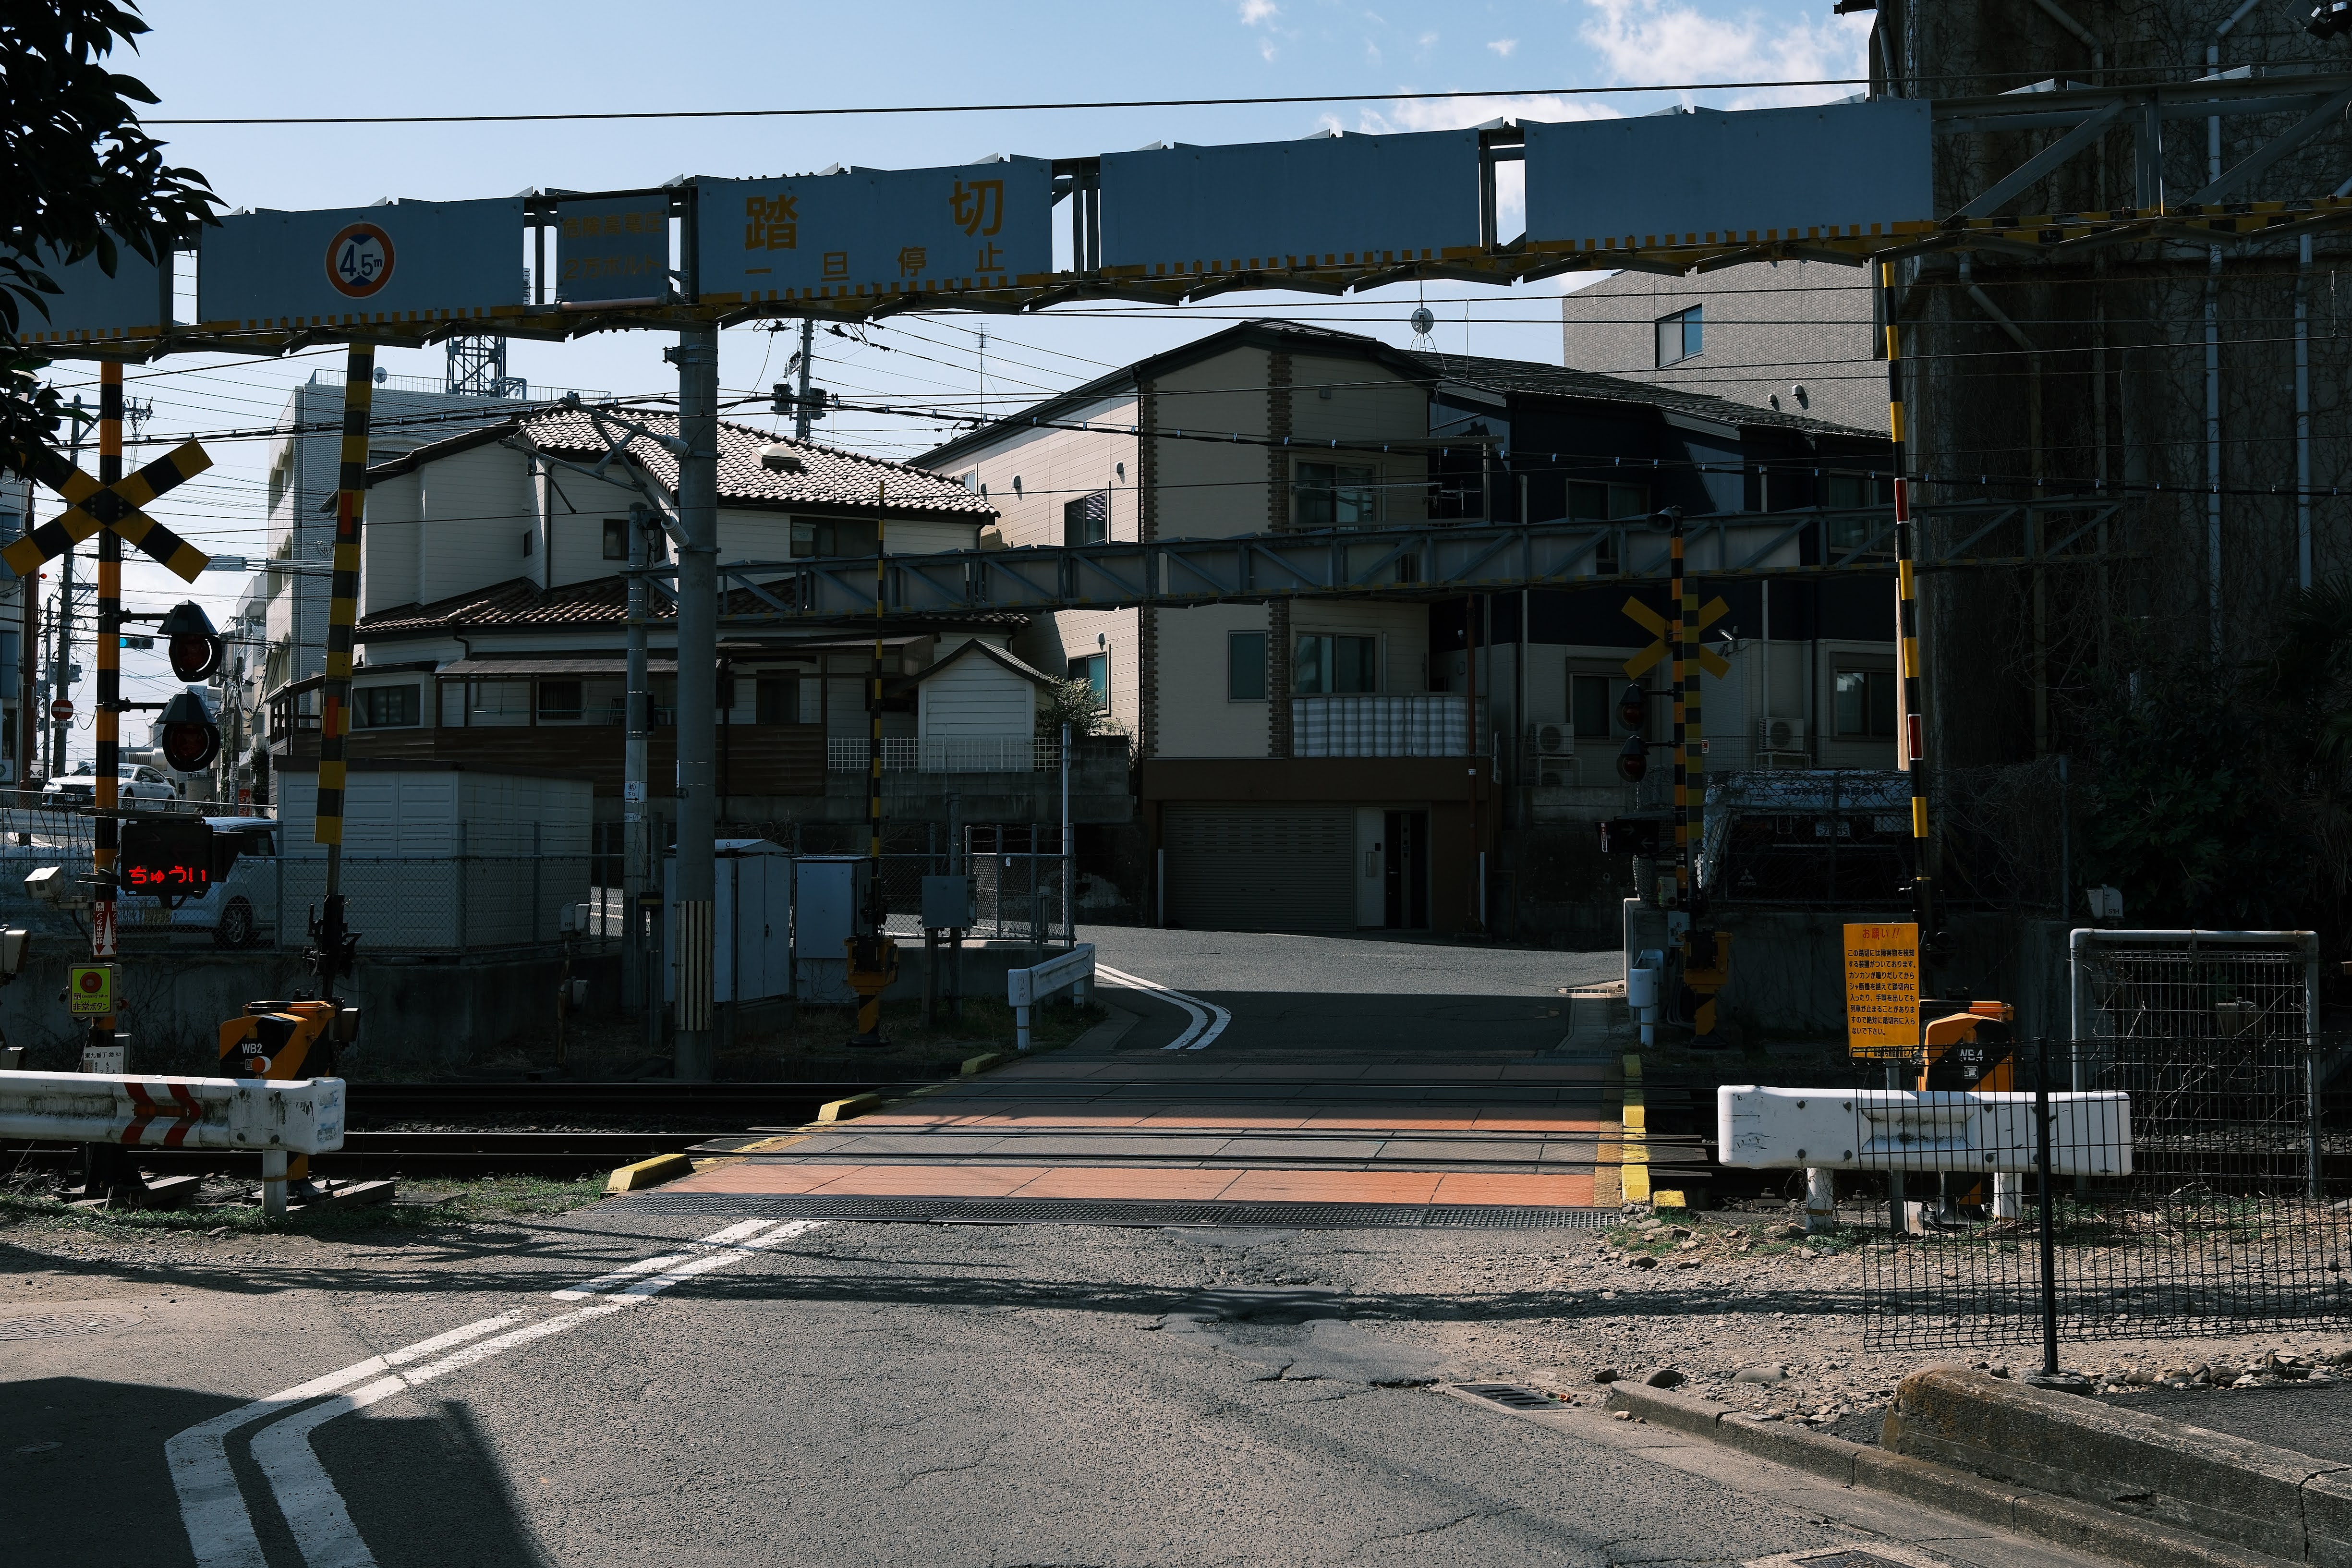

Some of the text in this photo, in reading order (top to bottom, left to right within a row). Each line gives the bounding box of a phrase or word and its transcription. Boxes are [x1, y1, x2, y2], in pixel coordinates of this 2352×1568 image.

[745, 179, 1004, 250] 踏切
[562, 212, 663, 238] 危険高電圧
[339, 244, 382, 276] 4.5m
[745, 242, 1005, 281] 一旦停止
[563, 254, 661, 280] 2万ボルト
[128, 865, 206, 884] ちゅうい
[1848, 949, 1915, 957] この踏切には障害物を検知
[1849, 983, 1915, 991] シャ断機を越えて踏切内に
[73, 1003, 109, 1011] 非常ボタン
[1850, 1005, 1915, 1013] 列車が止まることがありま
[1851, 1016, 1915, 1025] すので絶対に踏切内に入ら
[1852, 1027, 1885, 1035] ないで下さい。
[242, 1043, 262, 1054] WB2
